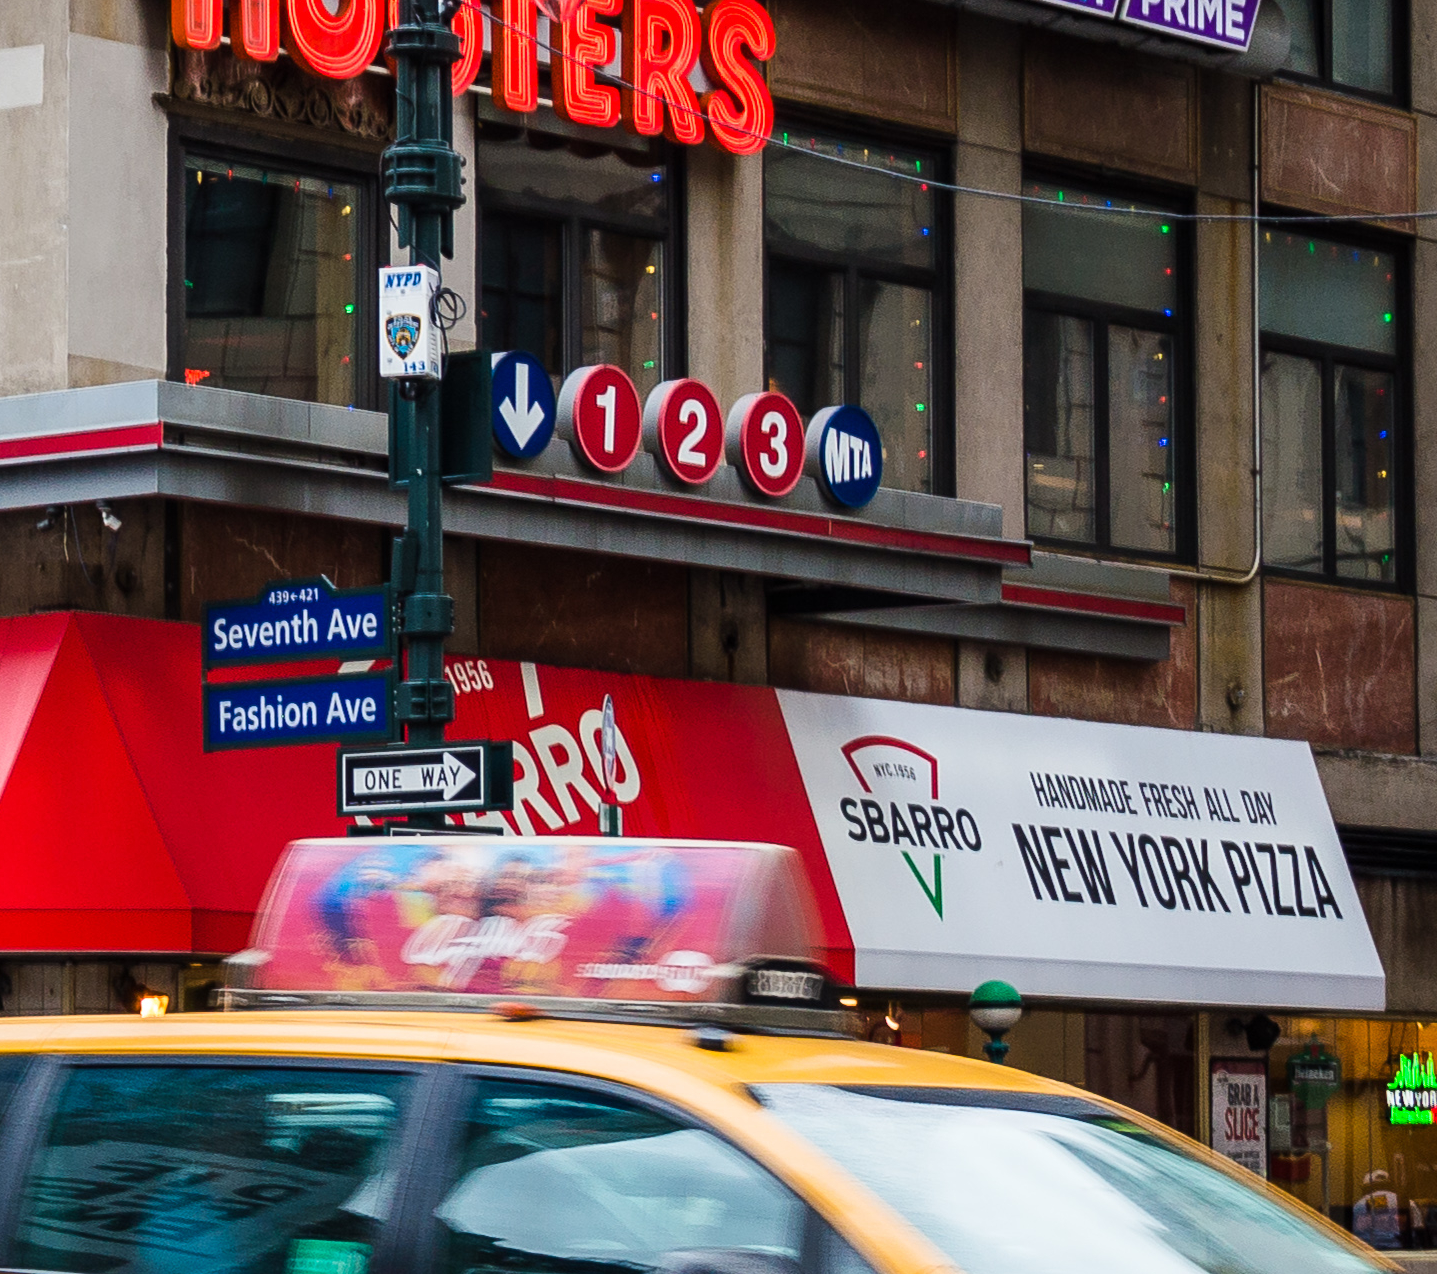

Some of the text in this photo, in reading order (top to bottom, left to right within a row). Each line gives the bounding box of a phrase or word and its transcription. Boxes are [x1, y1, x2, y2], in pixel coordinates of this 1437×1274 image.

[385, 271, 422, 288] NYPD
[404, 361, 425, 373] 143
[595, 385, 874, 485] 1 2 3 MTA
[269, 587, 319, 605] 439 421
[212, 606, 378, 653] Seventh Ave
[219, 691, 376, 734] Fashion Ave
[364, 765, 462, 791] ONE WAY
[872, 762, 917, 784] NYC.1956
[1030, 771, 1278, 826] HANDMADE FRESH ALL DAY
[839, 797, 983, 853] SBARRO
[1010, 822, 1344, 921] NEW YORK PIZZA
[1227, 1083, 1252, 1107] GRAB
[1386, 1089, 1414, 1108] NEW
[1225, 1106, 1261, 1141] SLICE
